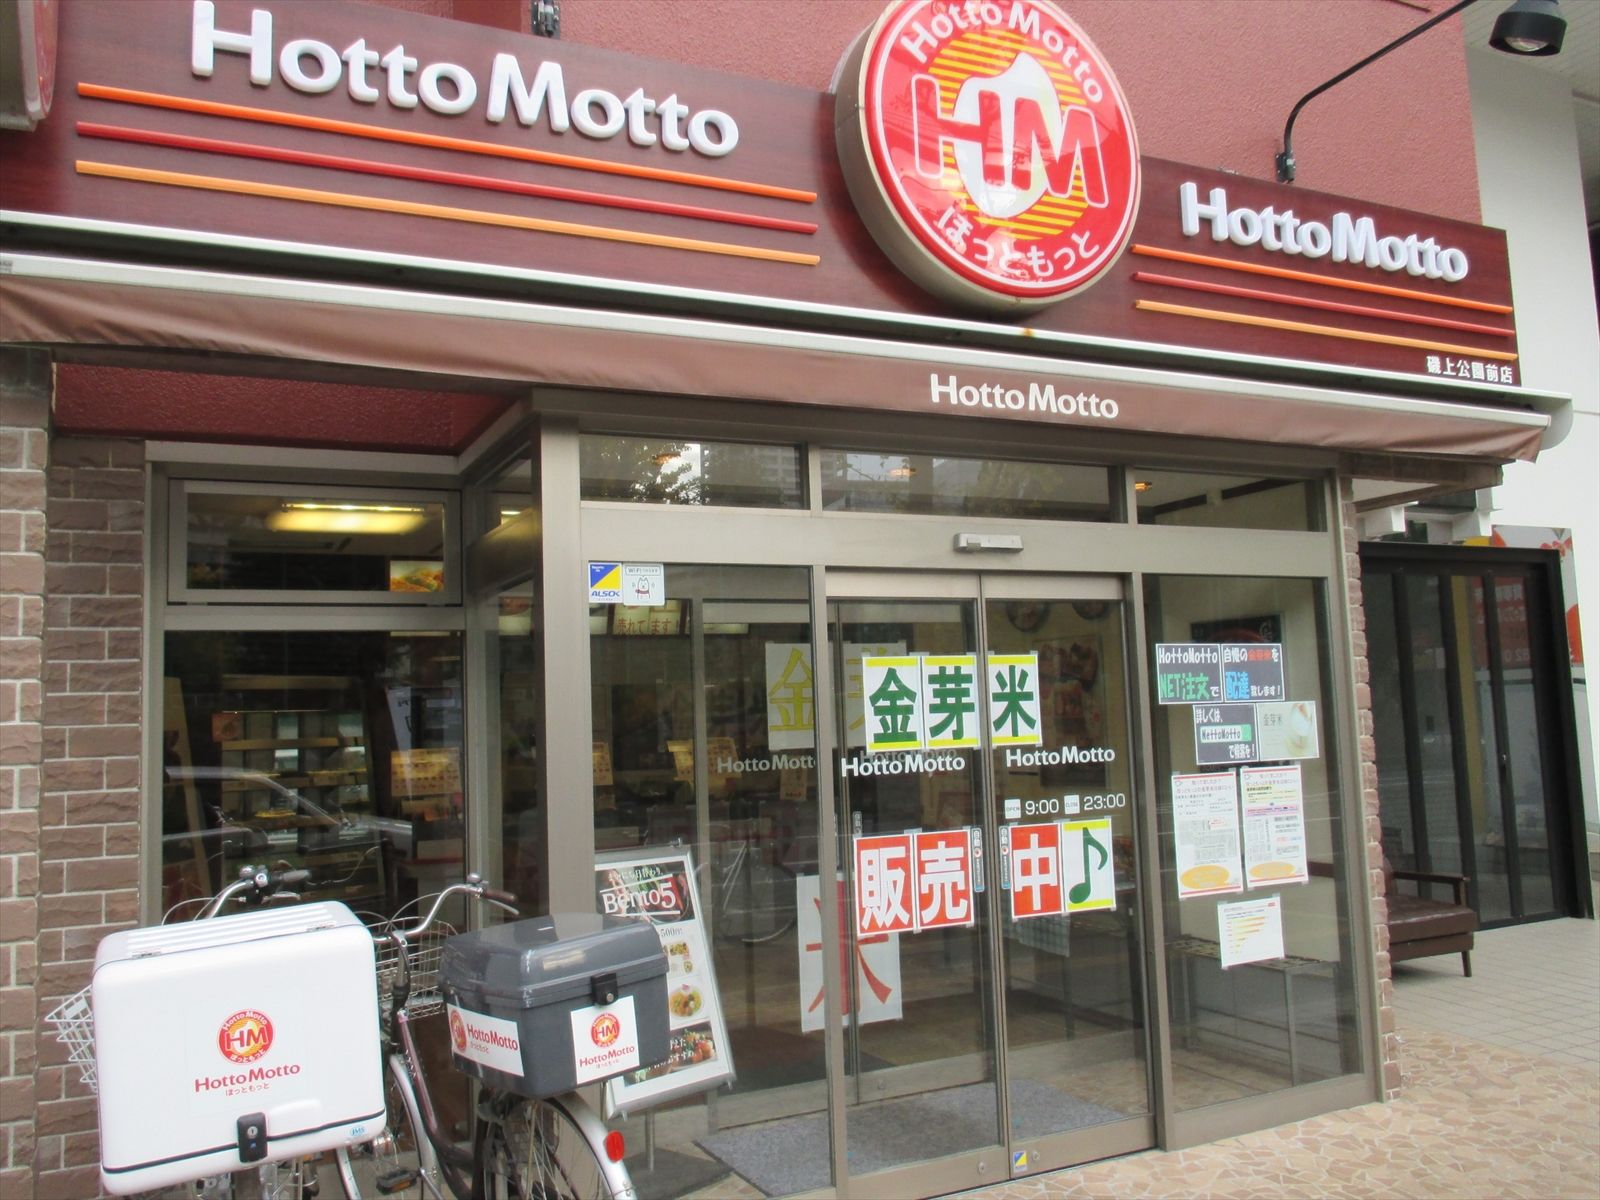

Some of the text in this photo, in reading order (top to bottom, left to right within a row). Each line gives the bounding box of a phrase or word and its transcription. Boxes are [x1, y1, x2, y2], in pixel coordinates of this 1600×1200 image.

[911, 74, 1110, 208] HM
[934, 205, 1100, 277] ほっともっと
[591, 590, 620, 598] ALSOK
[869, 664, 1036, 744] 金芽米
[1025, 798, 1060, 815] 9:00
[1083, 793, 1127, 811] 23:00
[860, 833, 1058, 930] 販売中
[226, 1027, 266, 1050] HM
[594, 1024, 617, 1040] HM
